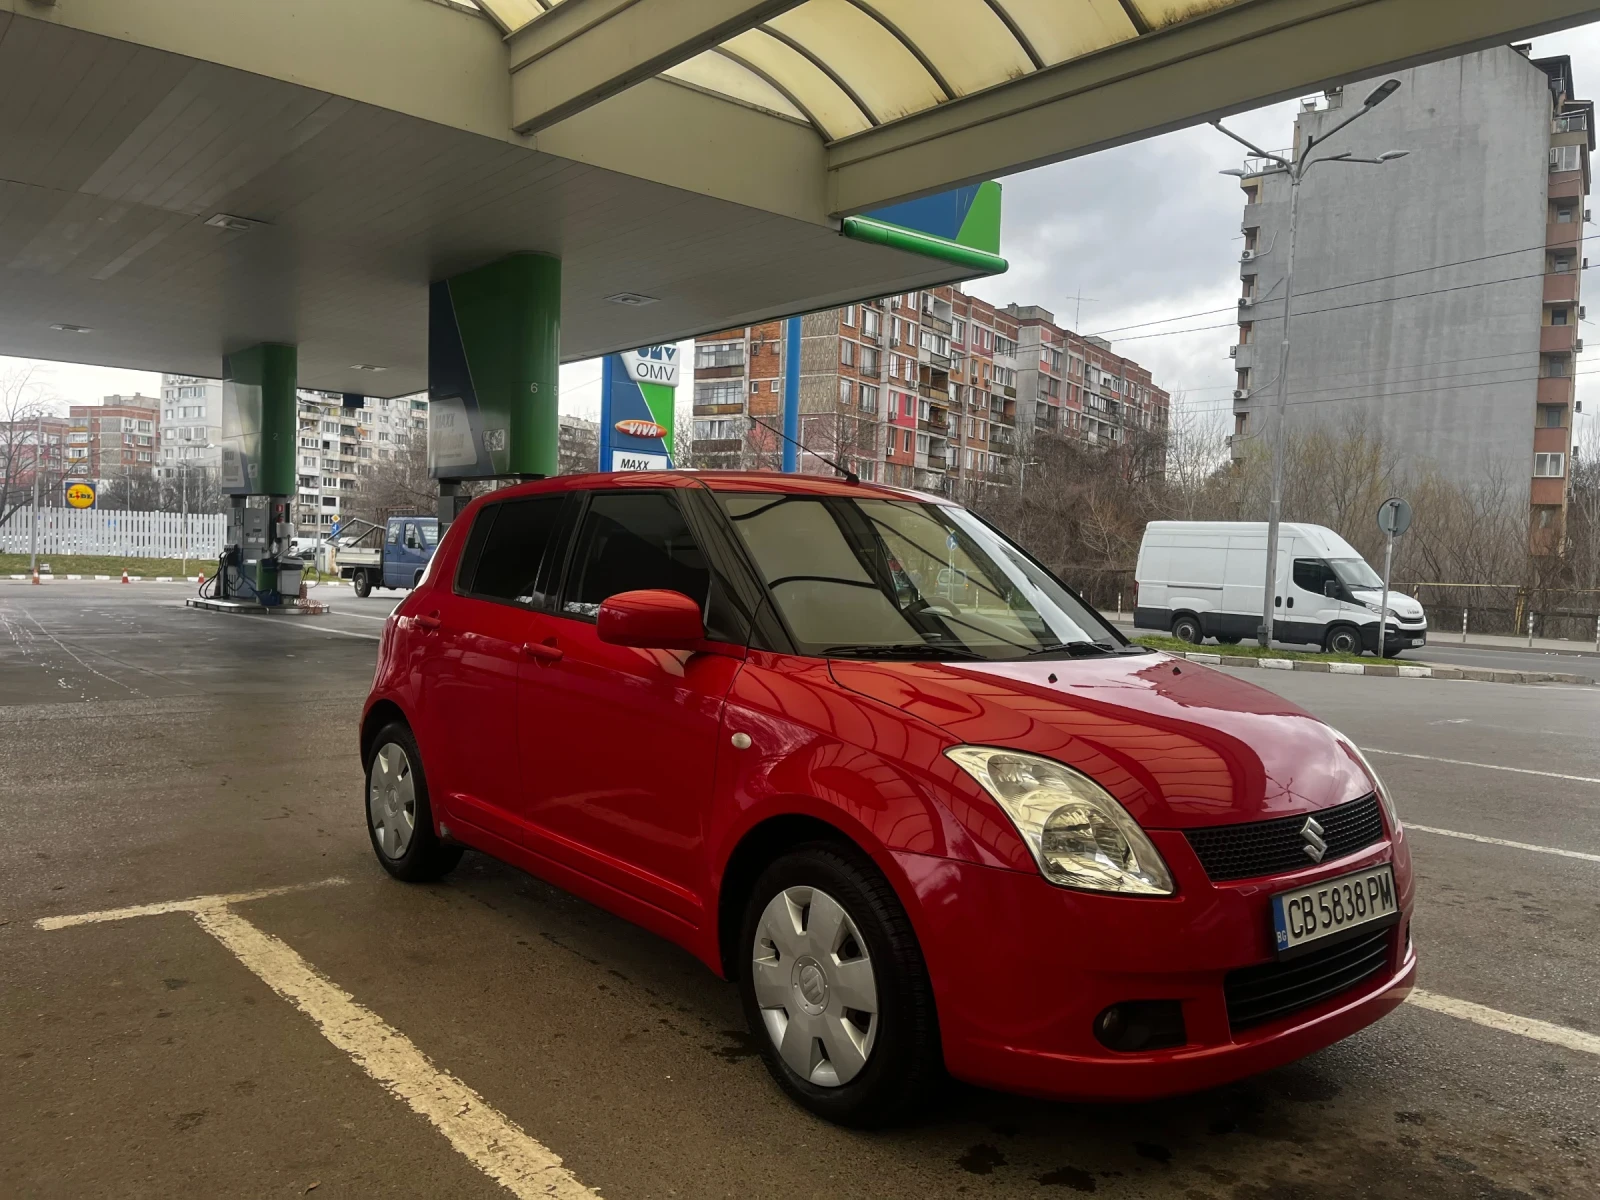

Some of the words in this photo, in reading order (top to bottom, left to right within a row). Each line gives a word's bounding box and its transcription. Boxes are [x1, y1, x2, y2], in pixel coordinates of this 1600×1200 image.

[636, 362, 675, 381] OMV
[530, 382, 539, 394] 6
[553, 385, 558, 396] 5
[628, 422, 659, 437] VIVA
[620, 458, 650, 470] MAXX
[1288, 896, 1317, 939] CB
[1318, 880, 1366, 928] 5838
[1367, 872, 1393, 915] PM
[1277, 931, 1287, 943] BG
